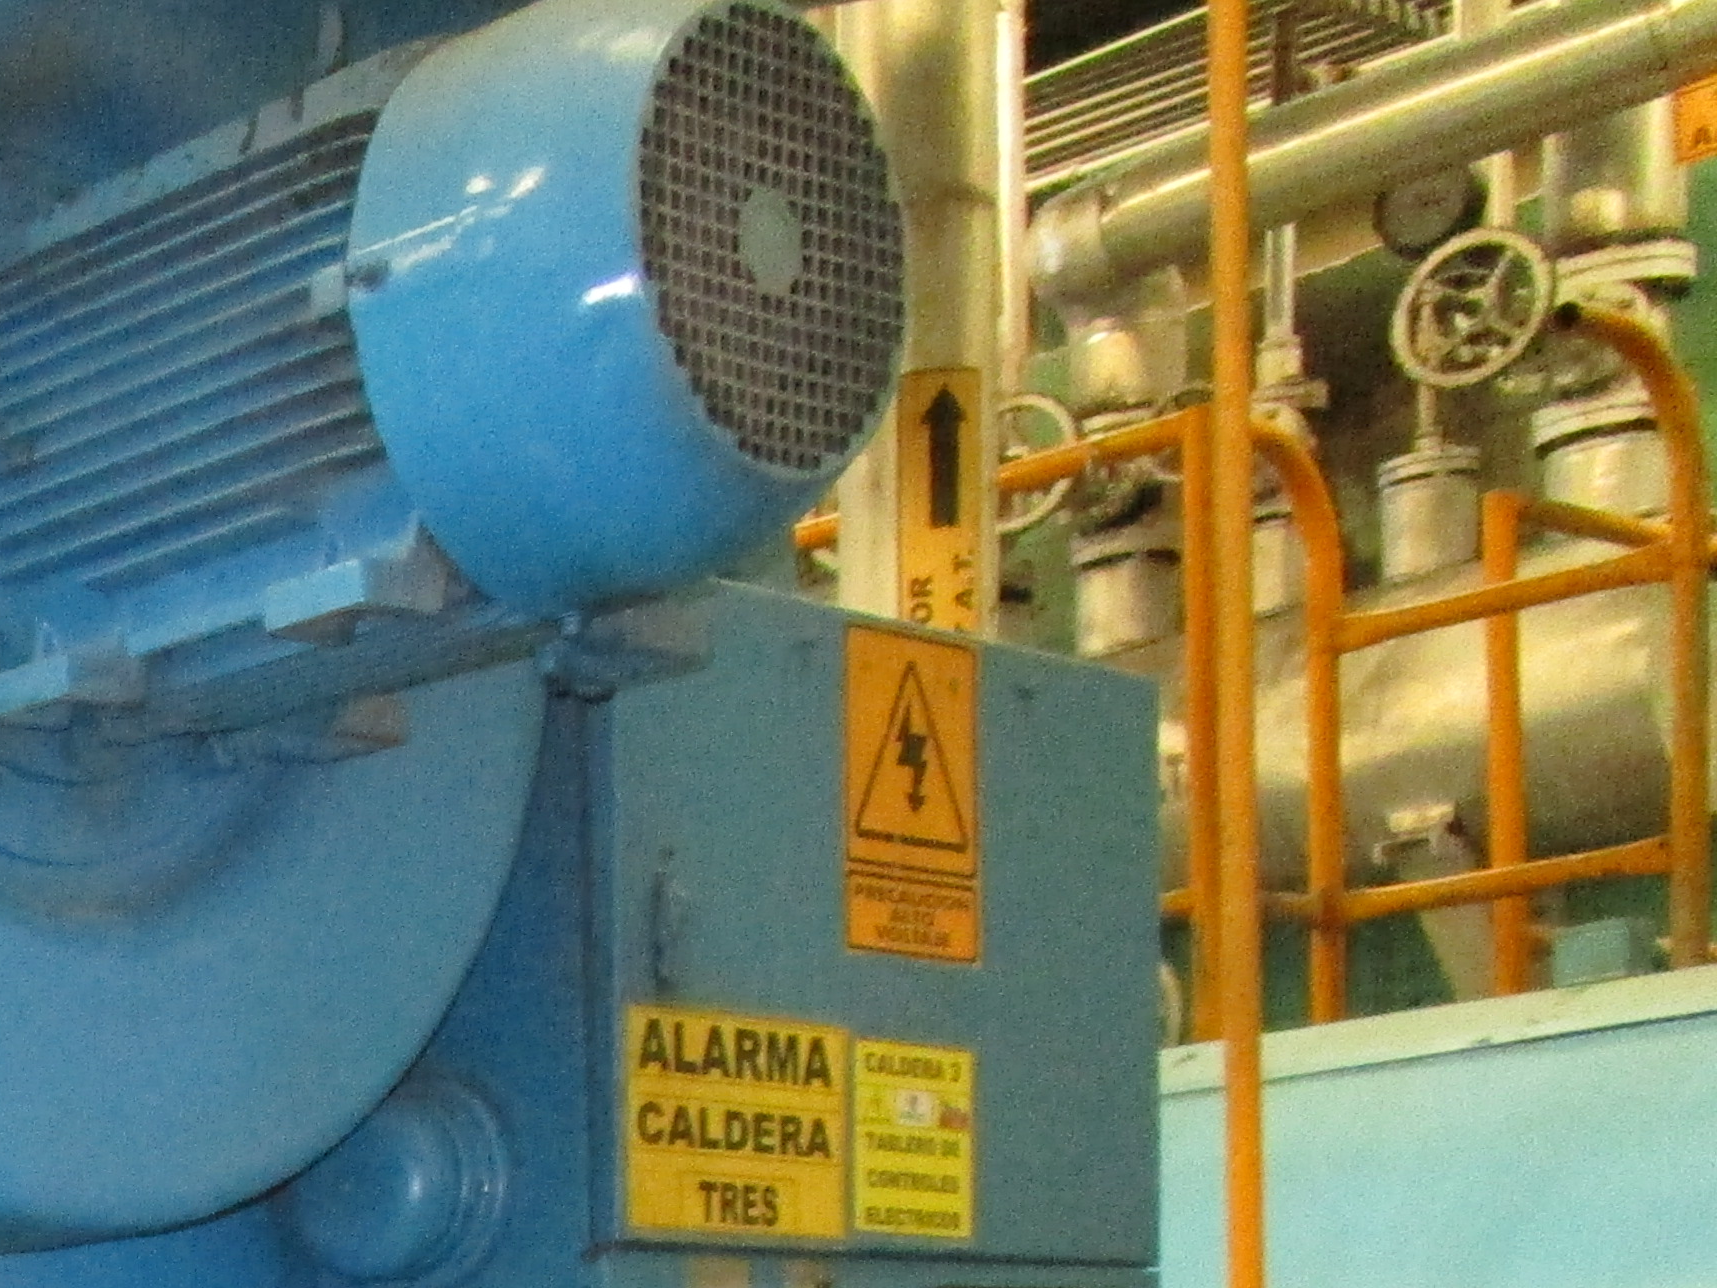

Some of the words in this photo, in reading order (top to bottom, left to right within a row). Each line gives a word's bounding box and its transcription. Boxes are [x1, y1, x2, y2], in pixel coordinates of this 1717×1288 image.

[639, 1017, 832, 1088] ALARMA
[865, 1052, 944, 1081] CALDERA
[638, 1100, 831, 1160] CALDERA
[698, 1179, 780, 1227] TRES
